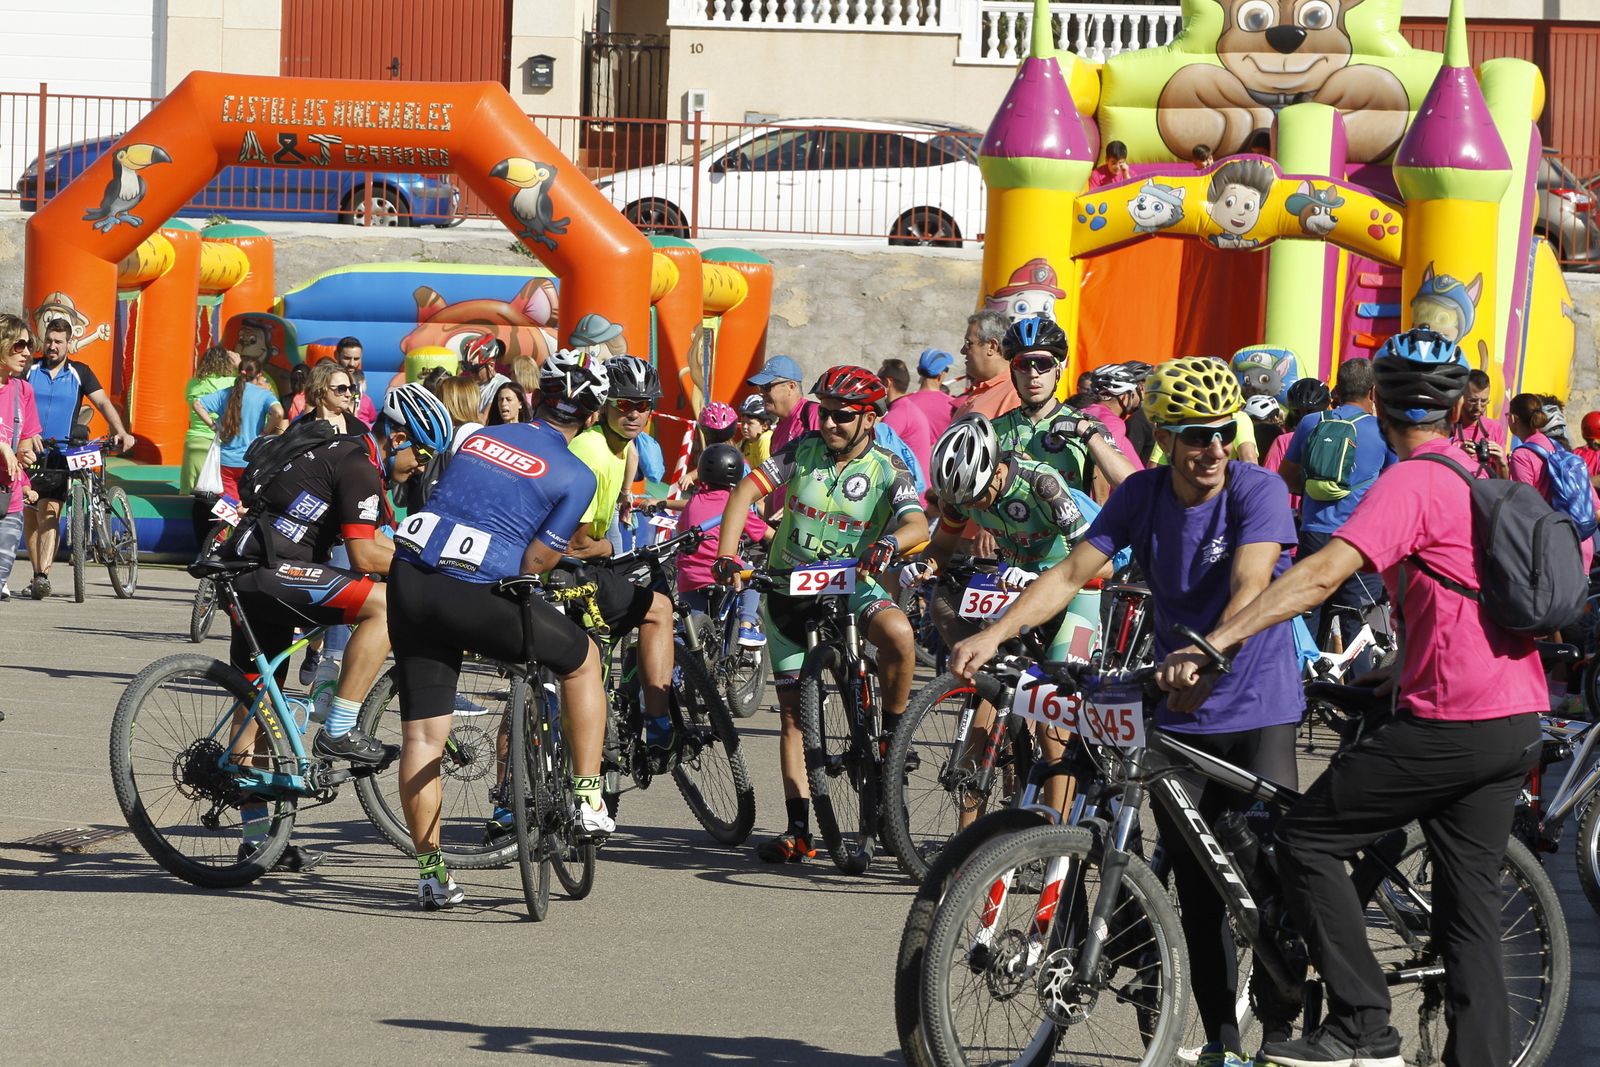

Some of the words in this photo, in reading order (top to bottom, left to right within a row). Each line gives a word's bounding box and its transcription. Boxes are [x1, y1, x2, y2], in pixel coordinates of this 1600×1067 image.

[690, 43, 704, 54] 10
[222, 95, 328, 126] CASTILLOS
[332, 100, 453, 131] HINCHABLES
[238, 130, 270, 165] A
[72, 454, 97, 469] 153
[467, 439, 537, 471] ABUS
[407, 517, 424, 535] 0
[459, 536, 474, 555] 0
[787, 527, 857, 559] ALSA
[797, 571, 848, 591] 294
[964, 592, 1010, 615] 367
[1024, 684, 1081, 727] 163
[1086, 707, 1136, 742] 345
[1162, 777, 1257, 909] SCOTT
